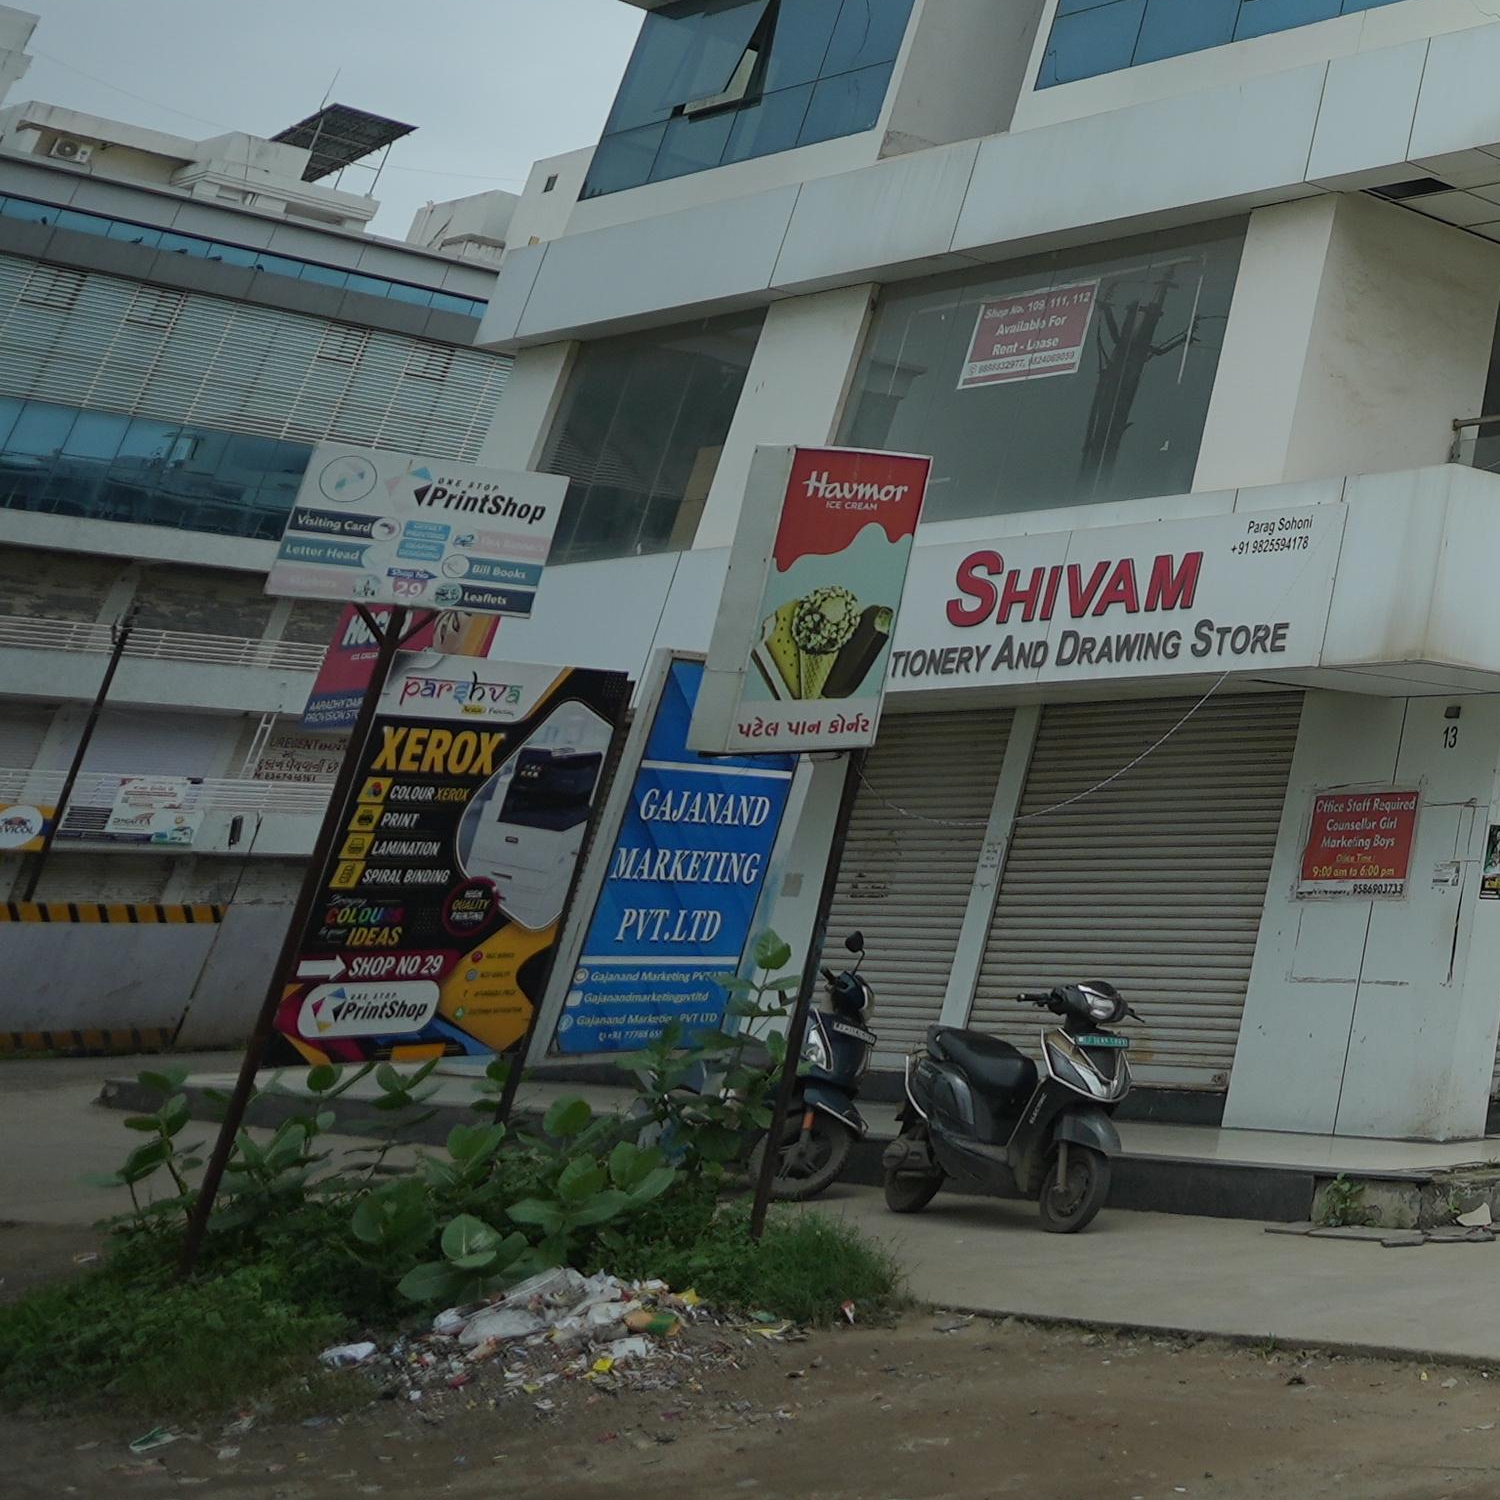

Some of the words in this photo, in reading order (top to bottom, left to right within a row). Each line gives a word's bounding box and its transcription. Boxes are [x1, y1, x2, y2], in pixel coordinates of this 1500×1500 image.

[1047, 314, 1067, 328] For
[802, 470, 909, 502] Havmor
[427, 486, 547, 524] PrintShop
[826, 500, 841, 510] ICE
[844, 501, 878, 511] CREAM
[297, 513, 342, 532] Visiting
[343, 519, 372, 534] Card
[1247, 520, 1276, 535] Parag
[1278, 514, 1314, 531] Sohoni
[285, 543, 323, 558] Letter
[326, 547, 360, 561] Head
[1231, 541, 1250, 555] +91
[1252, 535, 1310, 554] 9825594178
[472, 564, 490, 575] Bill
[493, 567, 526, 580] Books
[395, 581, 422, 598] 29
[463, 591, 507, 604] Leaflets
[946, 550, 1204, 628] SHIVAM
[890, 643, 990, 680] TIONERY
[991, 632, 1050, 672] AND
[1055, 625, 1181, 668] DRAWING
[1190, 619, 1290, 657] STORE
[738, 715, 780, 738] પટેલ
[787, 718, 821, 736] પાન
[827, 712, 870, 734] કોર્નર
[1442, 725, 1459, 749] 13
[371, 725, 506, 778] XEROX
[390, 784, 435, 801] COLOUR
[434, 787, 471, 801] XEROX
[639, 788, 771, 828] GAJANAND
[1316, 799, 1345, 813] Office
[1346, 798, 1372, 812] Staff
[1373, 796, 1416, 813] Required
[380, 812, 420, 828] PRINT
[1379, 816, 1398, 829] Girl
[371, 839, 441, 857] LAMINATION
[1321, 835, 1371, 850] Marketing
[1373, 834, 1396, 850] Boys
[609, 847, 762, 885] MARKETING
[1312, 865, 1332, 878] 9:00
[1333, 869, 1347, 877] am
[1349, 867, 1358, 876] to
[1360, 865, 1380, 876] 6:00
[362, 868, 402, 884] SPIRAL
[404, 868, 451, 885] BINDING
[614, 908, 722, 943] PVT.LTD
[345, 926, 403, 947] IDEAS
[348, 956, 396, 977] SHOP
[396, 956, 420, 976] NO
[421, 954, 444, 975] 29
[590, 971, 640, 983] Gajanand
[641, 971, 690, 983] Marketing
[340, 1000, 428, 1022] PrintShop
[576, 1014, 626, 1027] Gajanand
[627, 1013, 673, 1025] Marketin
